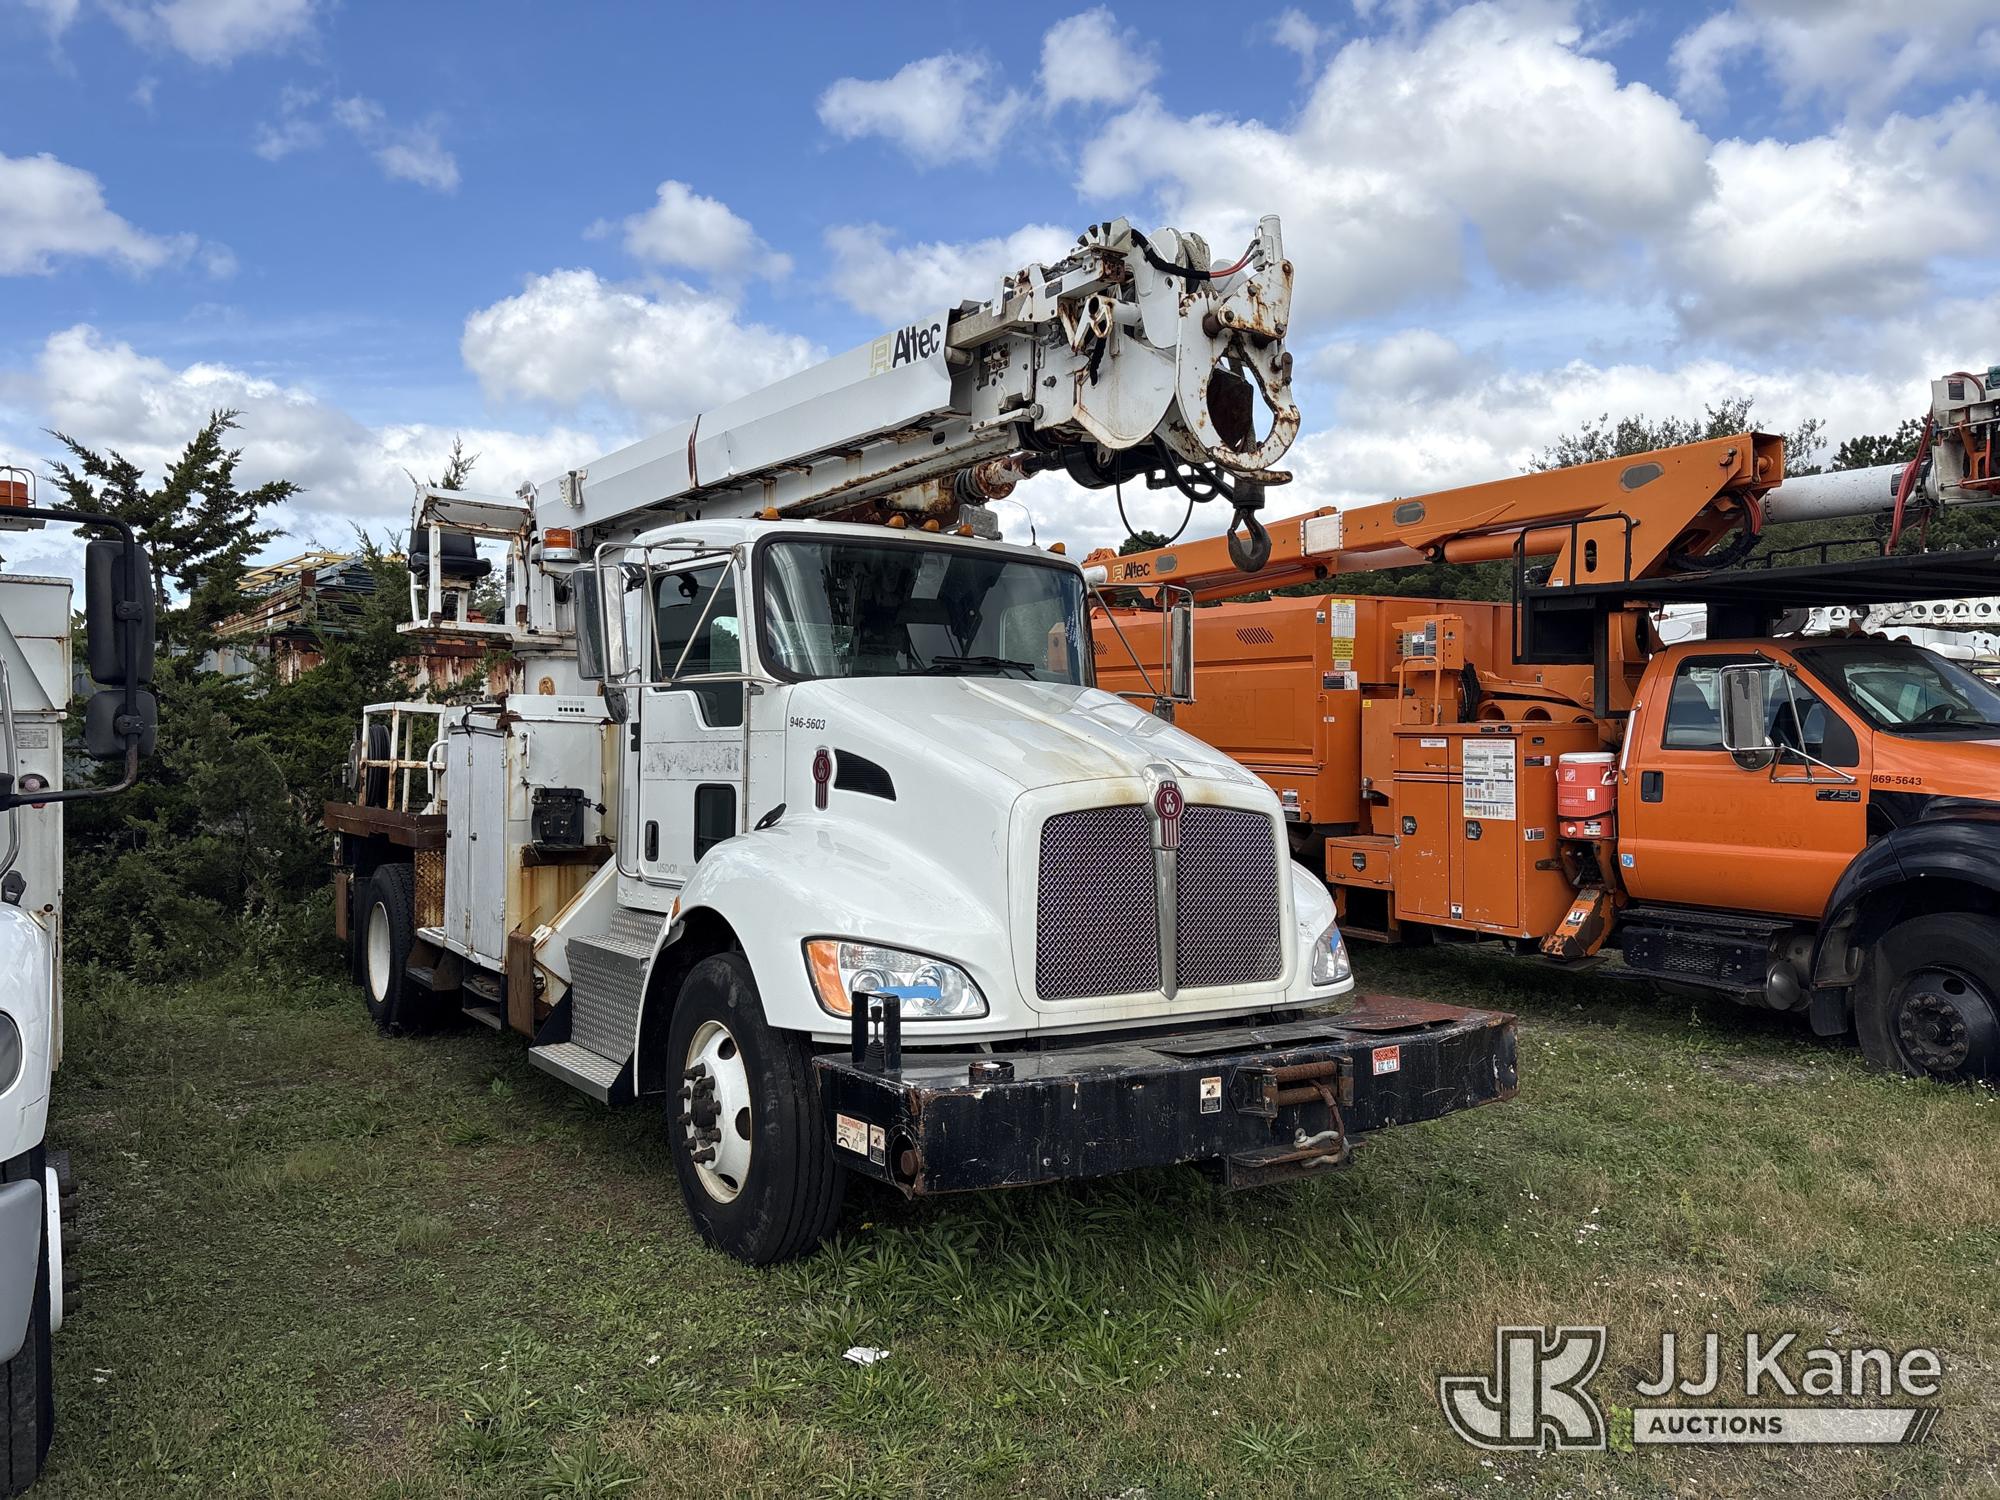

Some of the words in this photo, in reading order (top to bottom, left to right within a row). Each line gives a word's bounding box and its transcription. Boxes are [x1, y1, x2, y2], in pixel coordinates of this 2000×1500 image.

[891, 323, 941, 369] Altec
[1124, 561, 1150, 579] Altec
[789, 716, 826, 730] 946-5603
[1872, 774, 1922, 786] 869-5643
[1166, 792, 1174, 803] K
[1164, 803, 1176, 814] W
